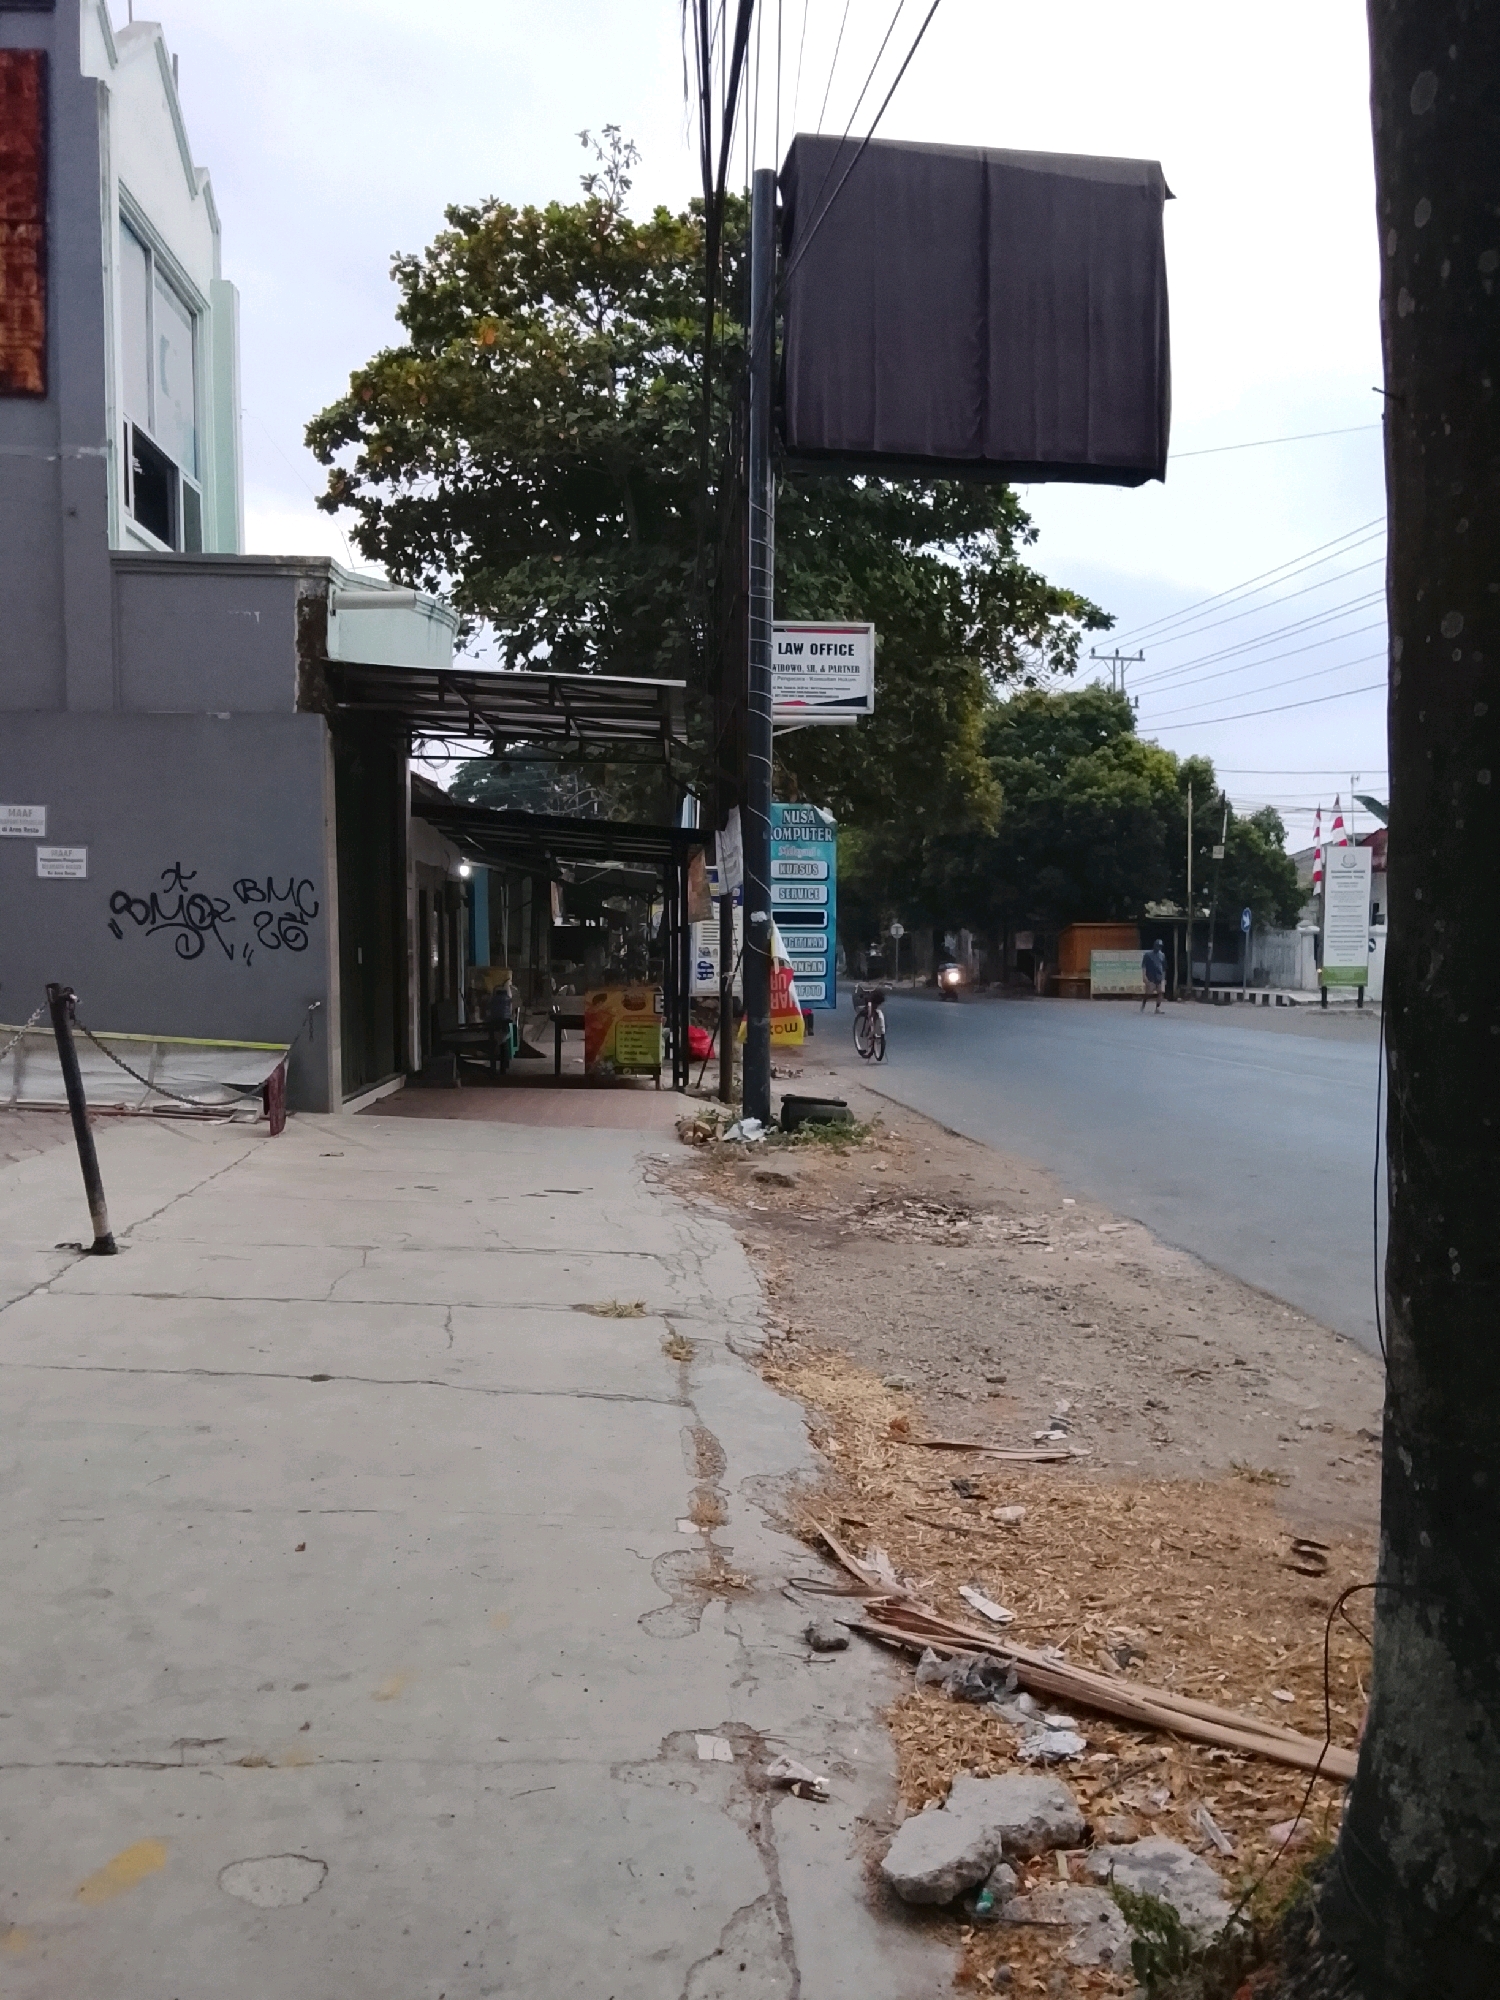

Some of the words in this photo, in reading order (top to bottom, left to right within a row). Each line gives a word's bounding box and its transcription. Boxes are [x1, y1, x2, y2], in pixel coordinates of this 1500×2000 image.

[778, 642, 804, 655] LAW
[810, 643, 855, 656] OFFICE
[782, 809, 816, 824] NUSA
[771, 827, 833, 842] OMPUTER
[779, 863, 819, 875] KURSUS
[779, 888, 819, 899] SERVICE
